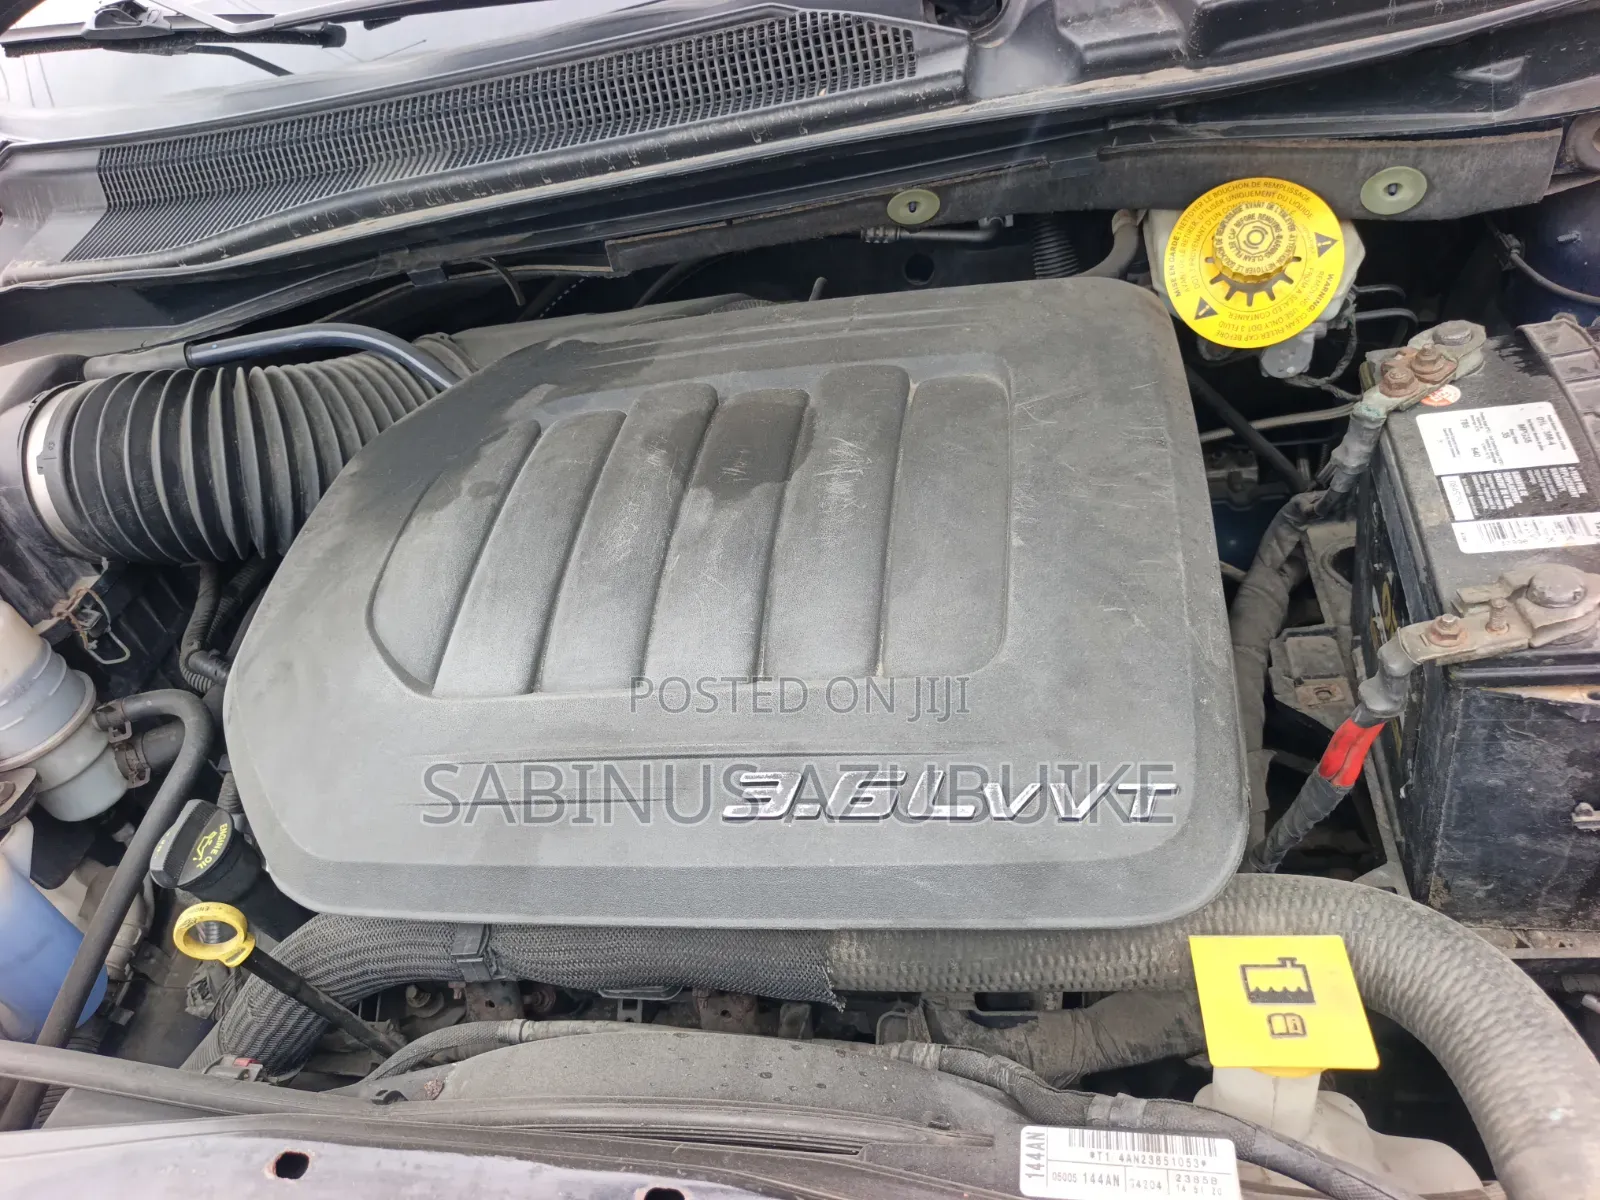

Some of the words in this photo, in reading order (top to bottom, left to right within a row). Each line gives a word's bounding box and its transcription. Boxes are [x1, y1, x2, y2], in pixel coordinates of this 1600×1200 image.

[1212, 182, 1249, 198] BOUCHON
[1264, 180, 1312, 204] REMPLISSAGE
[1202, 195, 1212, 204] LE
[1224, 190, 1276, 202] UNIQUEMENT
[1277, 193, 1289, 202] DU
[1288, 198, 1315, 220] LIQUIDE
[1177, 201, 1204, 231] NETTOYER
[1205, 211, 1222, 227] D'UN
[1234, 212, 1256, 229] BEFORE
[1169, 265, 1175, 276] EN
[1171, 278, 1182, 298] MISE
[1307, 273, 1334, 315] WARNING:
[1272, 294, 1300, 316] SEALED
[1249, 324, 1262, 332] DOT
[1265, 317, 1285, 329] ONLY
[211, 823, 228, 855] ENGINE
[196, 856, 213, 870] OIL
[1025, 1131, 1046, 1179] 144AN
[1082, 1173, 1120, 1188] 144AN
